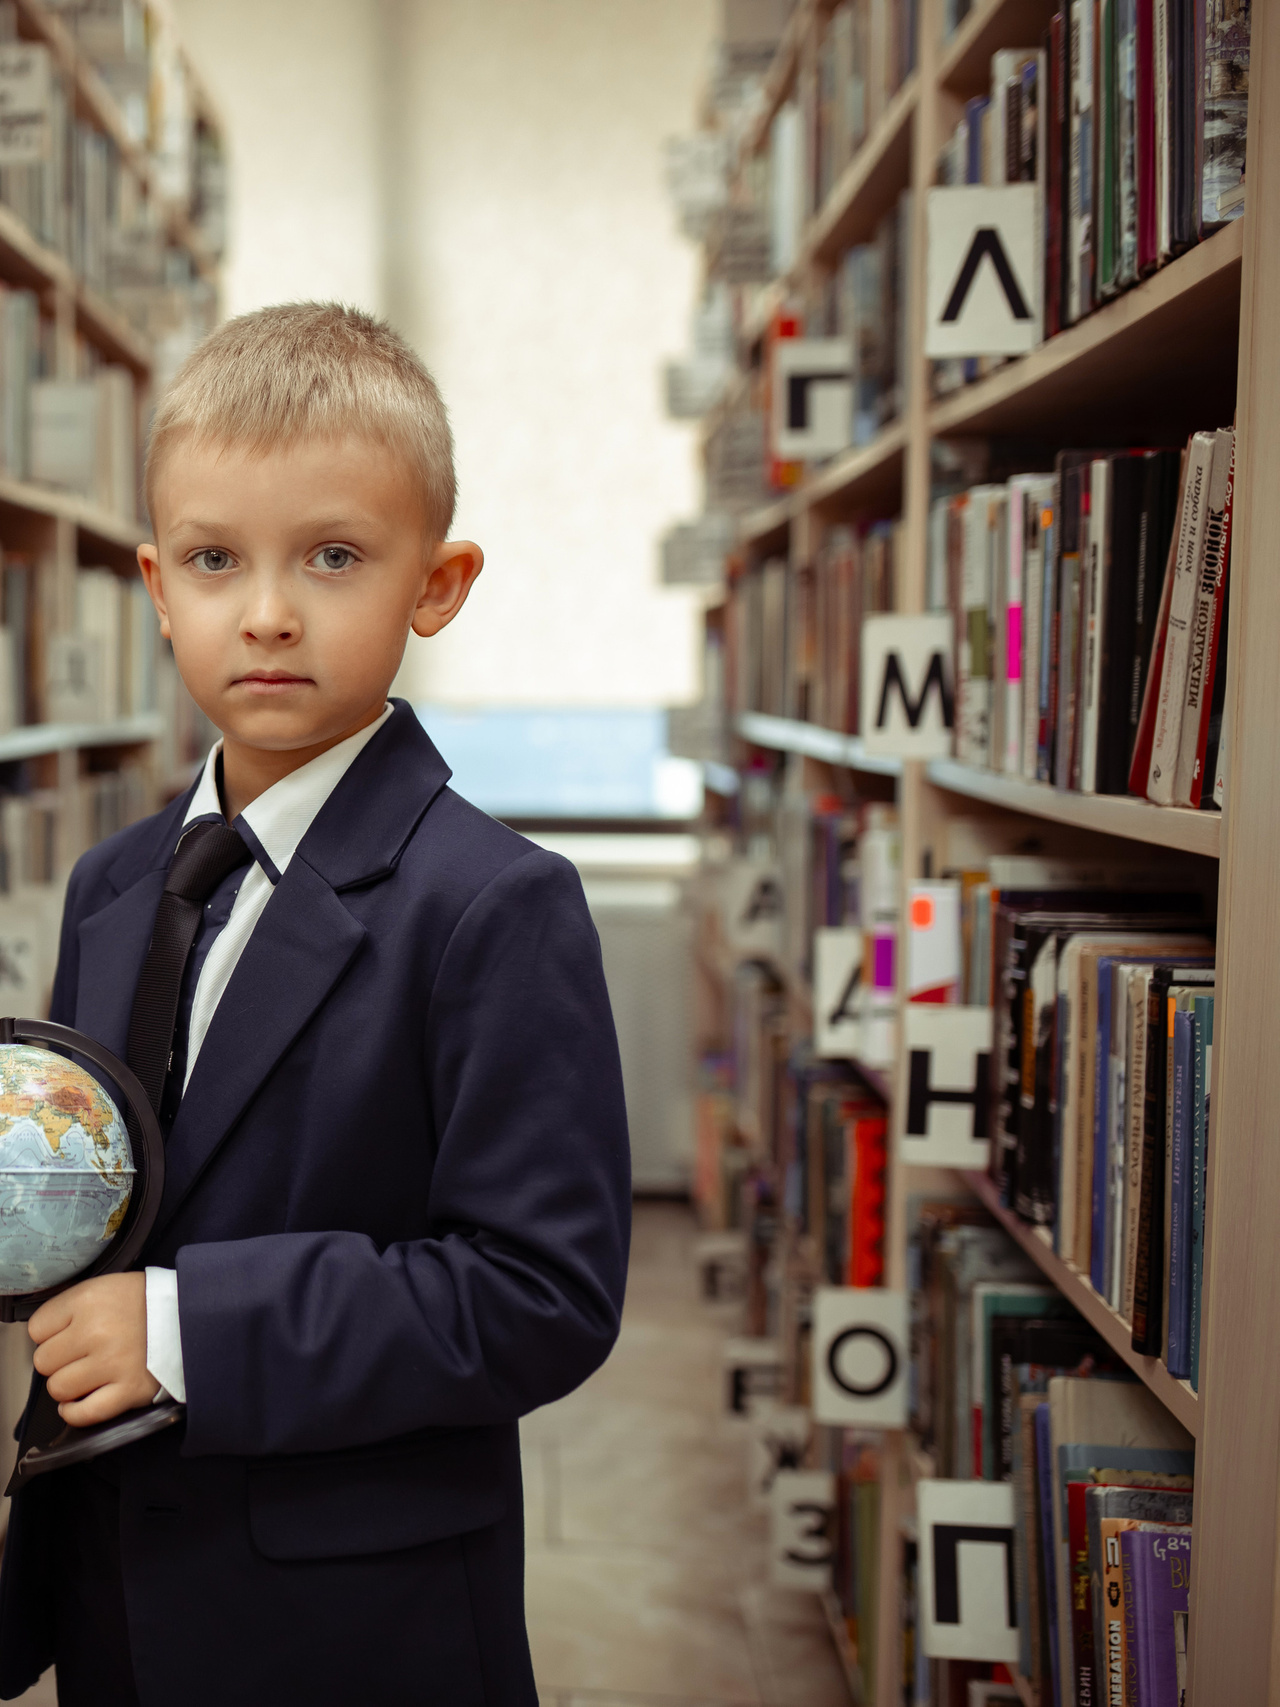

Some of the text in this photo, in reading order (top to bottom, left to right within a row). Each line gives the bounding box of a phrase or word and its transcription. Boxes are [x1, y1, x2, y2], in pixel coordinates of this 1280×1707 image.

[940, 227, 1033, 323] Л
[1184, 465, 1204, 573] кот и собака
[1215, 513, 1230, 587] ДОПЛЫТЬ
[1224, 482, 1233, 506] ДО
[1188, 506, 1224, 709] МИХАЛКОВ ЗВОНОК
[876, 651, 954, 730] М
[906, 1049, 993, 1140] Н
[1193, 1021, 1202, 1147] ВЛАСТЕЛИН
[828, 1326, 899, 1398] О
[933, 1524, 1019, 1629] П
[1107, 1619, 1123, 1707] NERATION
